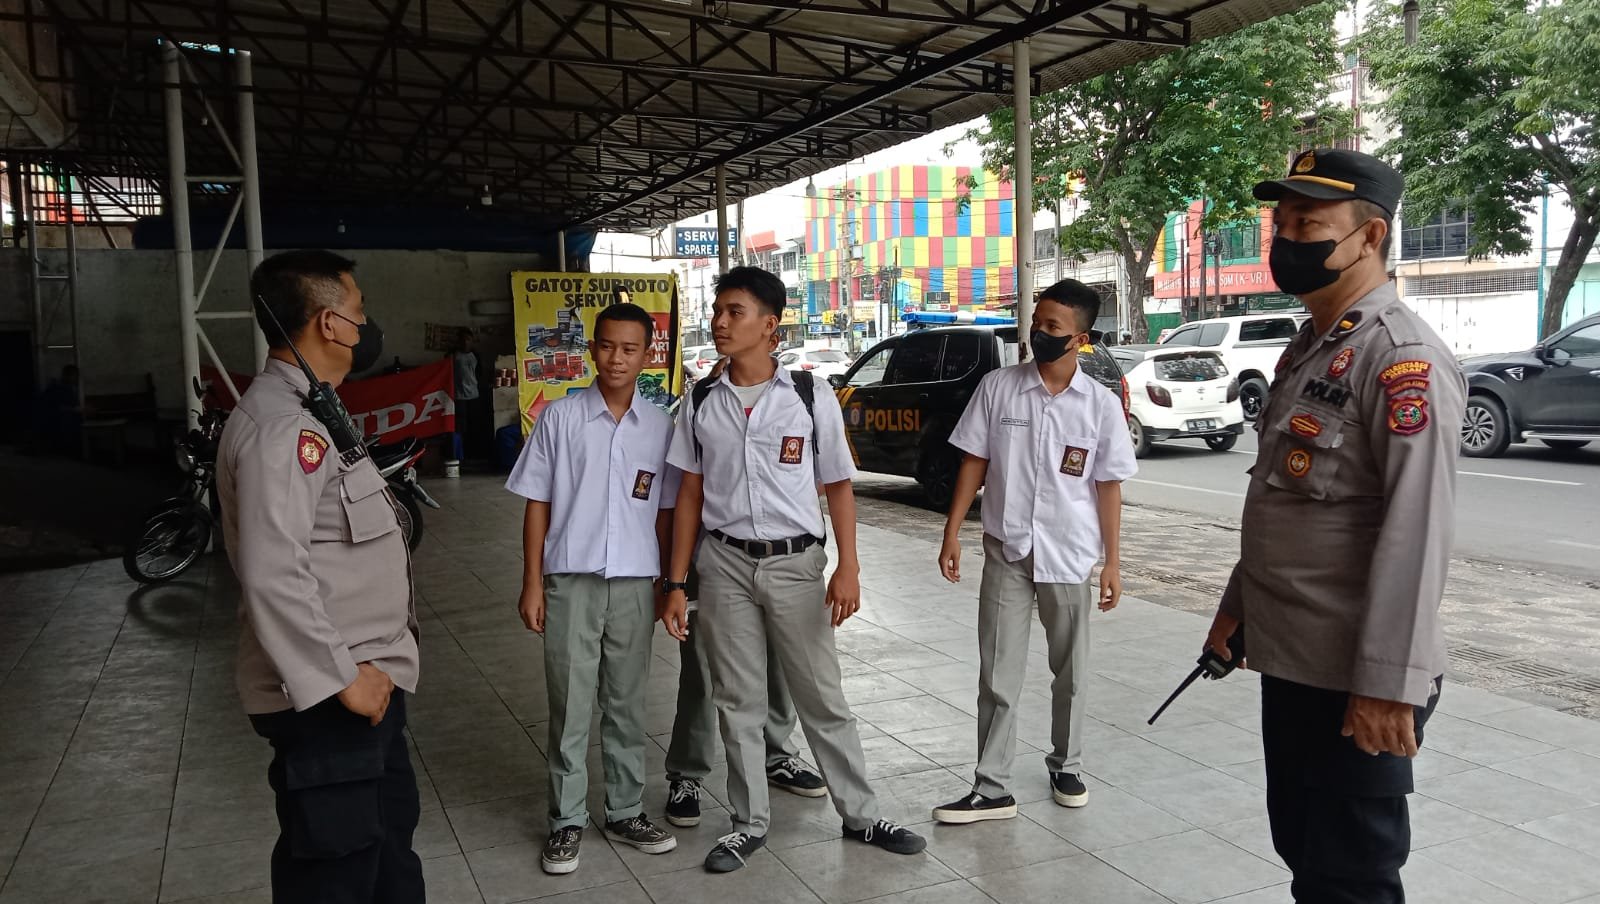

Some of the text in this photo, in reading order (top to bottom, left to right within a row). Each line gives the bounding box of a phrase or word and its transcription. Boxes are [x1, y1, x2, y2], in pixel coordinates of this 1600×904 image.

[684, 231, 736, 242] SERVIE
[684, 244, 713, 256] SPARE
[525, 278, 583, 293] GATOT
[865, 408, 920, 432] POLISI
